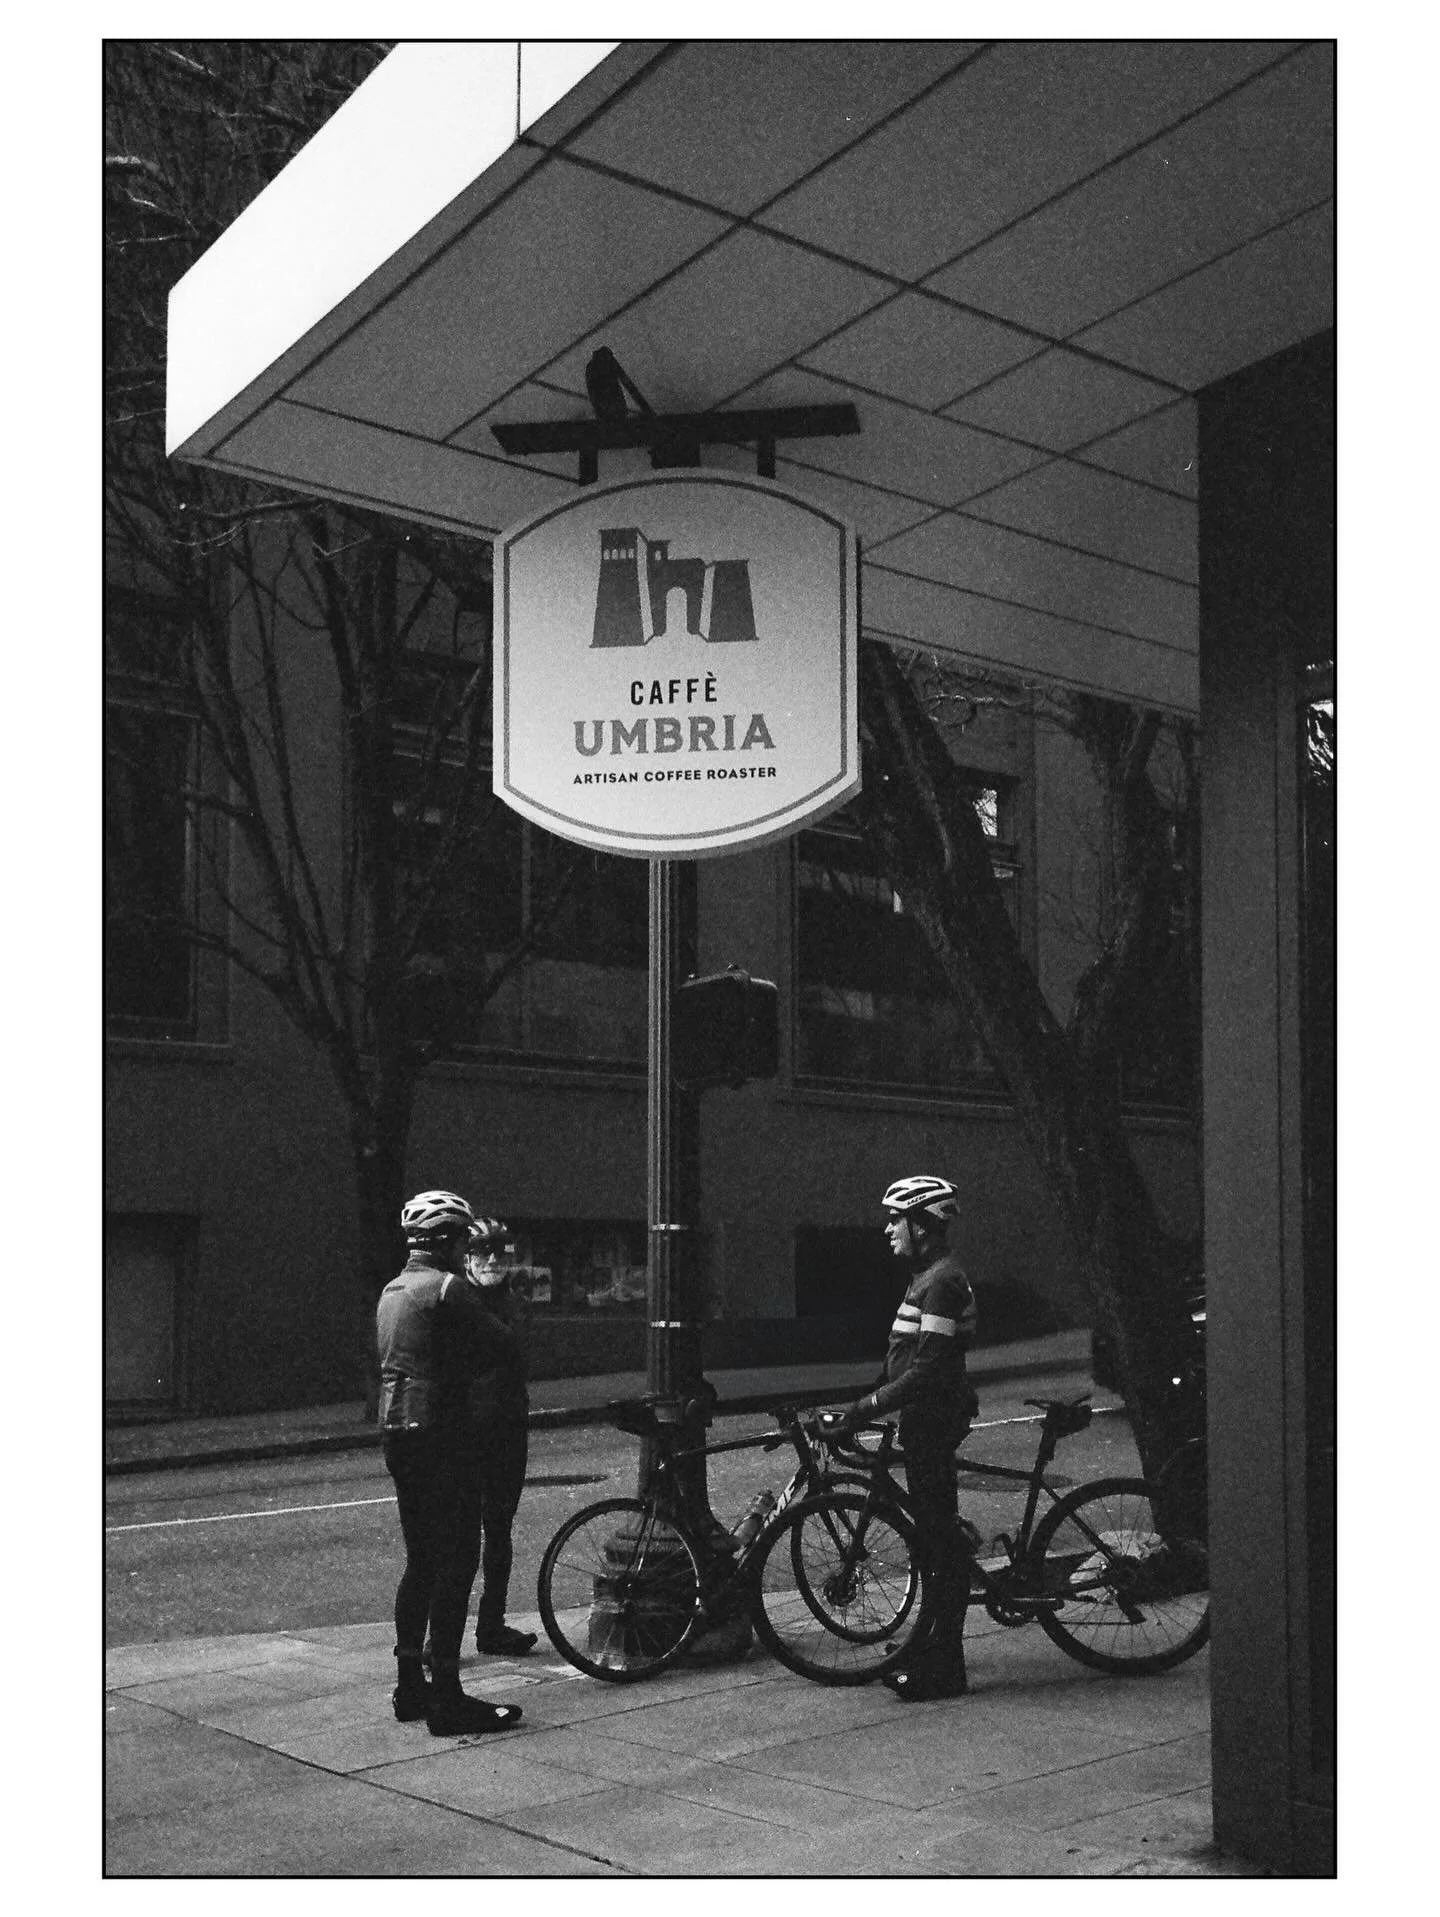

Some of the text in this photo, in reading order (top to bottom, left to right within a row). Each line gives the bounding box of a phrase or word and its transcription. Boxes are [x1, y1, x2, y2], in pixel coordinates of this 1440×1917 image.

[630, 671, 718, 706] CAFFÈ
[573, 713, 777, 757] UMBRIA
[573, 766, 777, 785] ARTISAN COFFEE ROASTER
